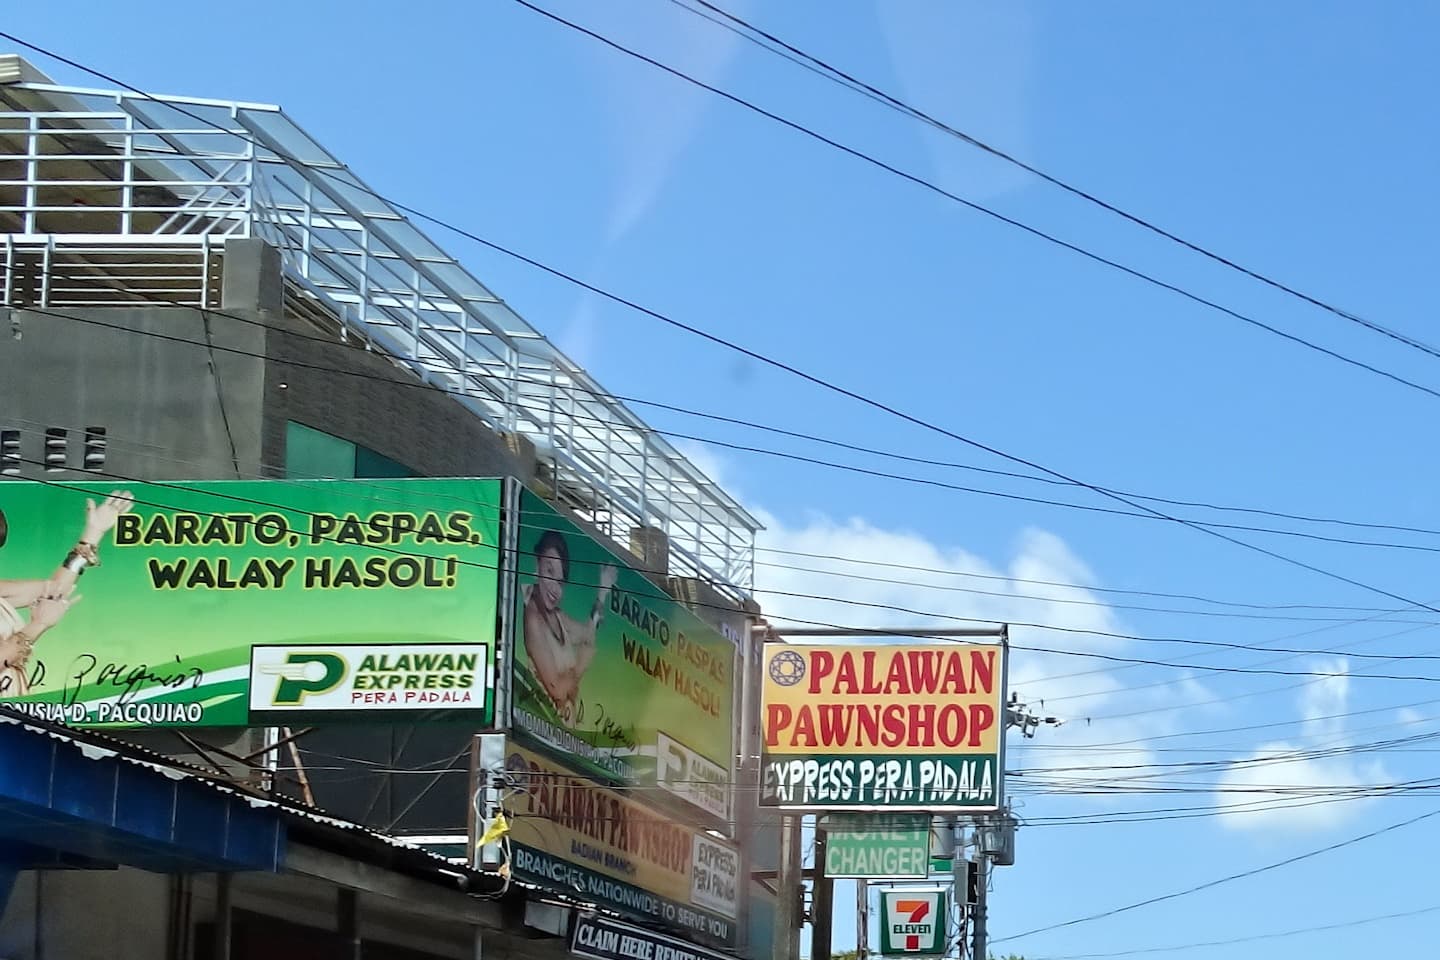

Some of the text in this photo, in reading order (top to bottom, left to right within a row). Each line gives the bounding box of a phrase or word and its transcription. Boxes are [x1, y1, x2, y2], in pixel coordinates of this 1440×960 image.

[115, 513, 481, 547] BARATO, PASPAS,
[149, 555, 458, 590] WALAY HASOL!
[610, 583, 674, 654] BARATO,
[622, 632, 672, 686] WALAY
[808, 651, 997, 694] PALAWAN
[351, 691, 473, 704] PERA PADALA
[353, 674, 474, 690] EXPRESS
[71, 702, 91, 723] D.
[98, 702, 203, 724] PACQUIAO
[766, 704, 996, 748] PAWNSHOP
[764, 760, 856, 804] EXPRESS
[858, 760, 914, 803] PERA
[918, 760, 993, 802] PADALA
[527, 761, 692, 875] PALAWAN PAWNSHOP
[697, 842, 736, 877] EXPRESS
[827, 846, 926, 875] CHANGER
[516, 849, 729, 941] BRANCHES NATIONWIDE TO SERVE YOU
[577, 924, 620, 951] CLAIM
[619, 935, 655, 960] HERE
